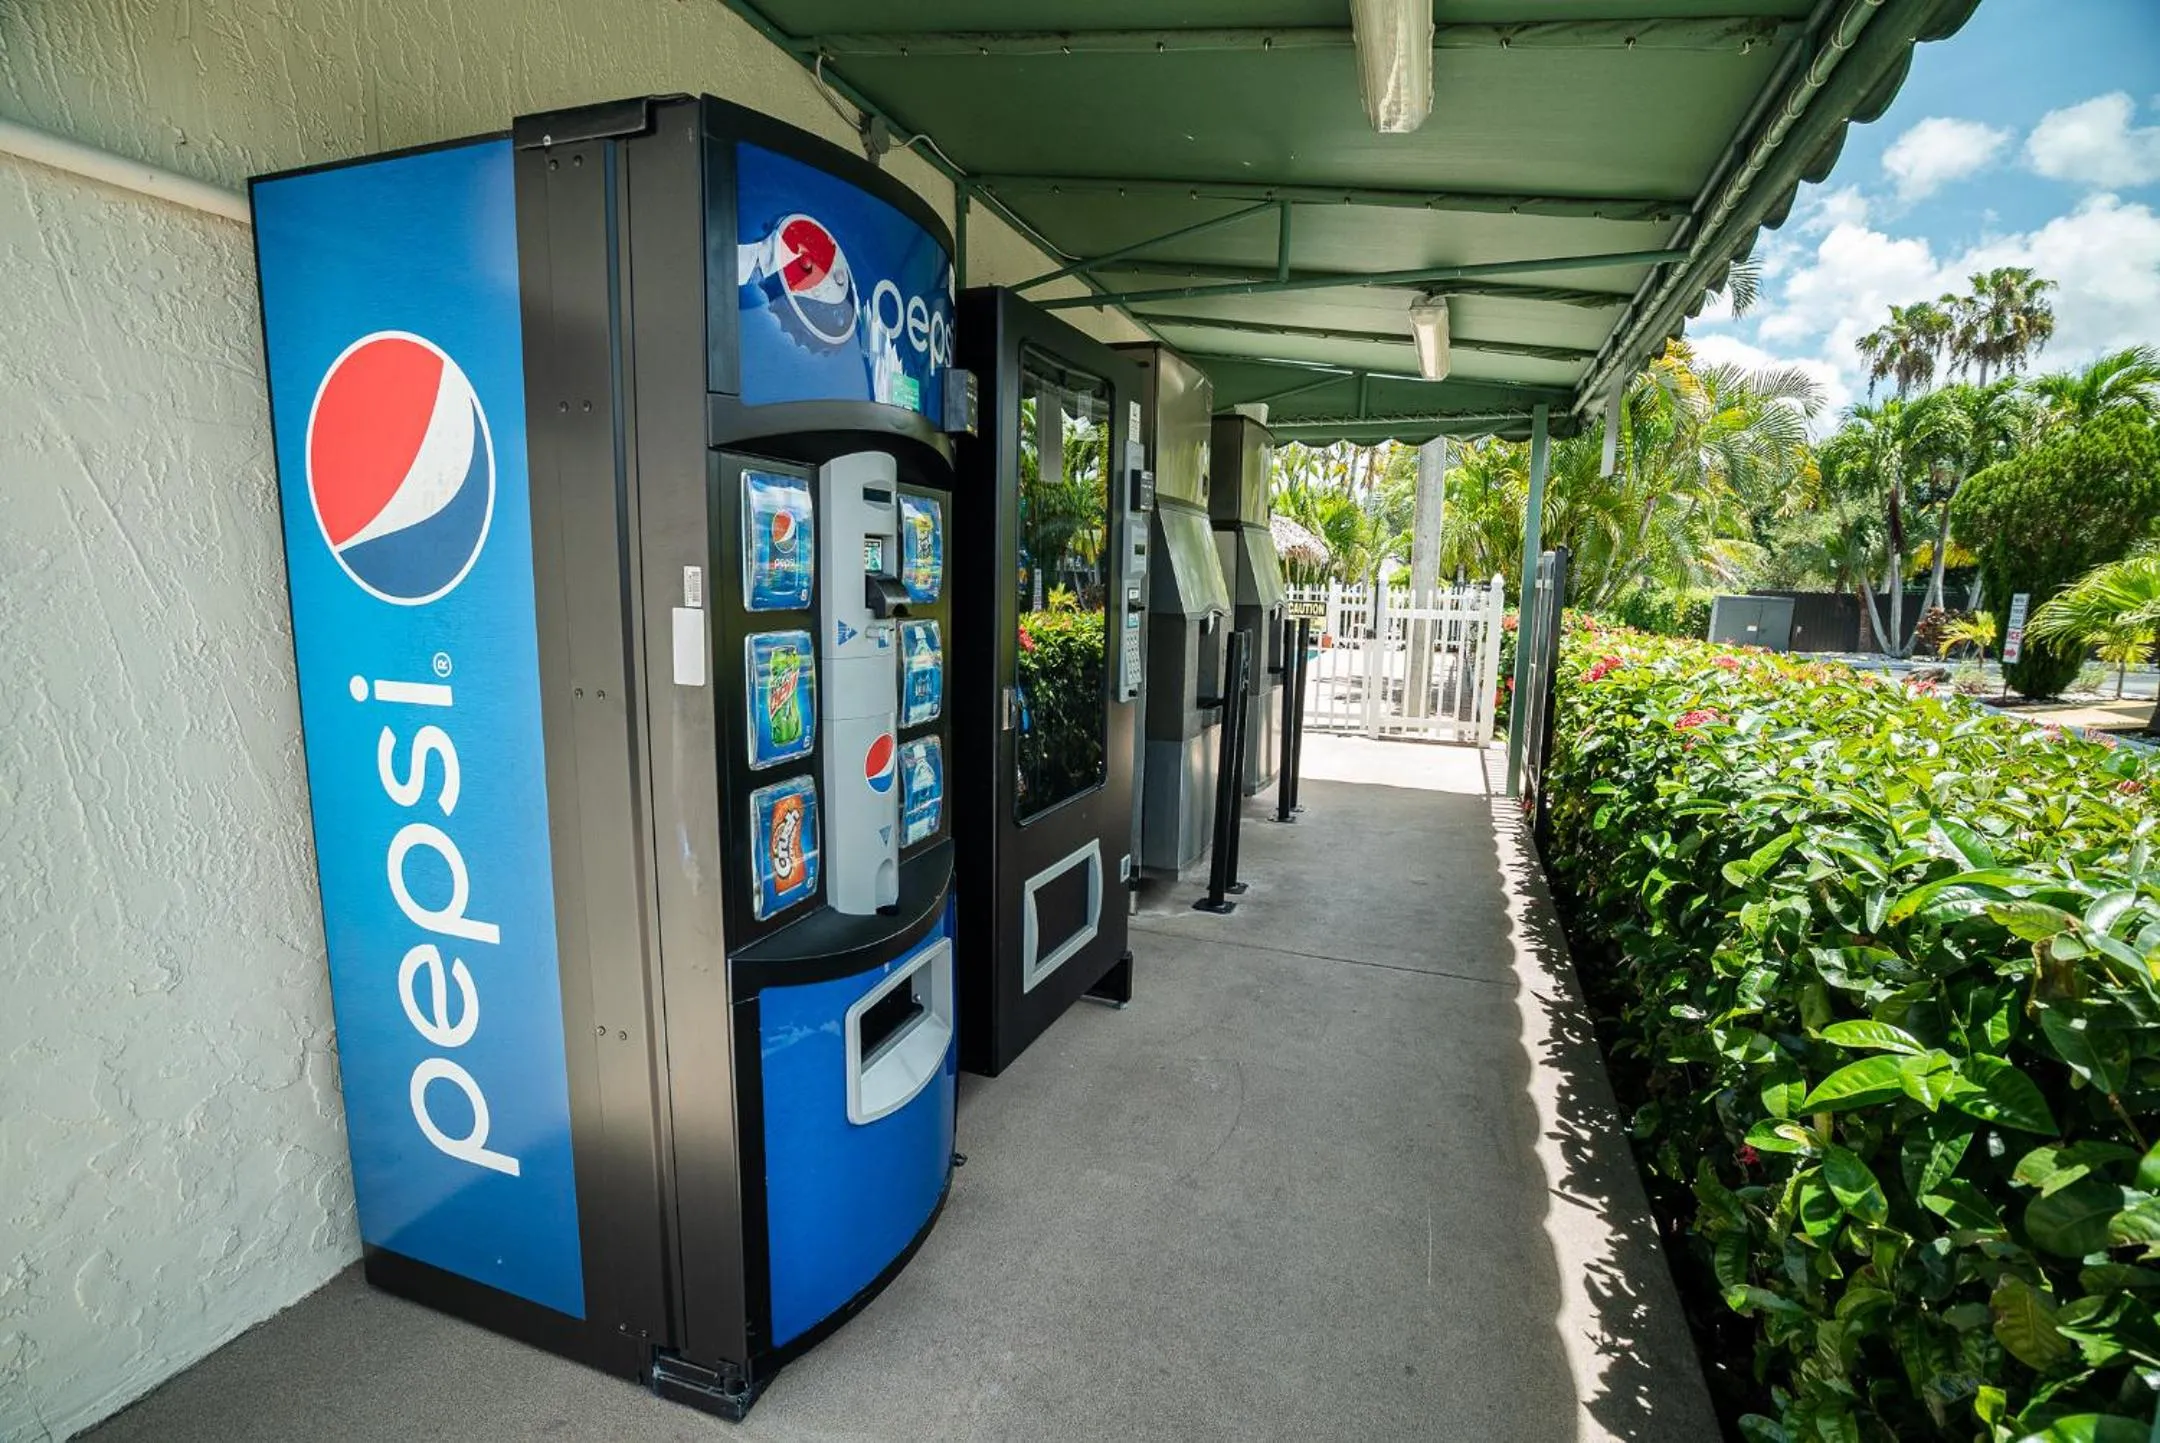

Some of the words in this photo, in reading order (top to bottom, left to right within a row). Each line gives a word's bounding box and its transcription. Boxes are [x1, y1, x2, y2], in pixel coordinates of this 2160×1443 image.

[871, 278, 956, 377] peps
[1288, 602, 1325, 616] CAUTION
[2008, 631, 2021, 641] ICE
[349, 676, 520, 1176] pepsi
